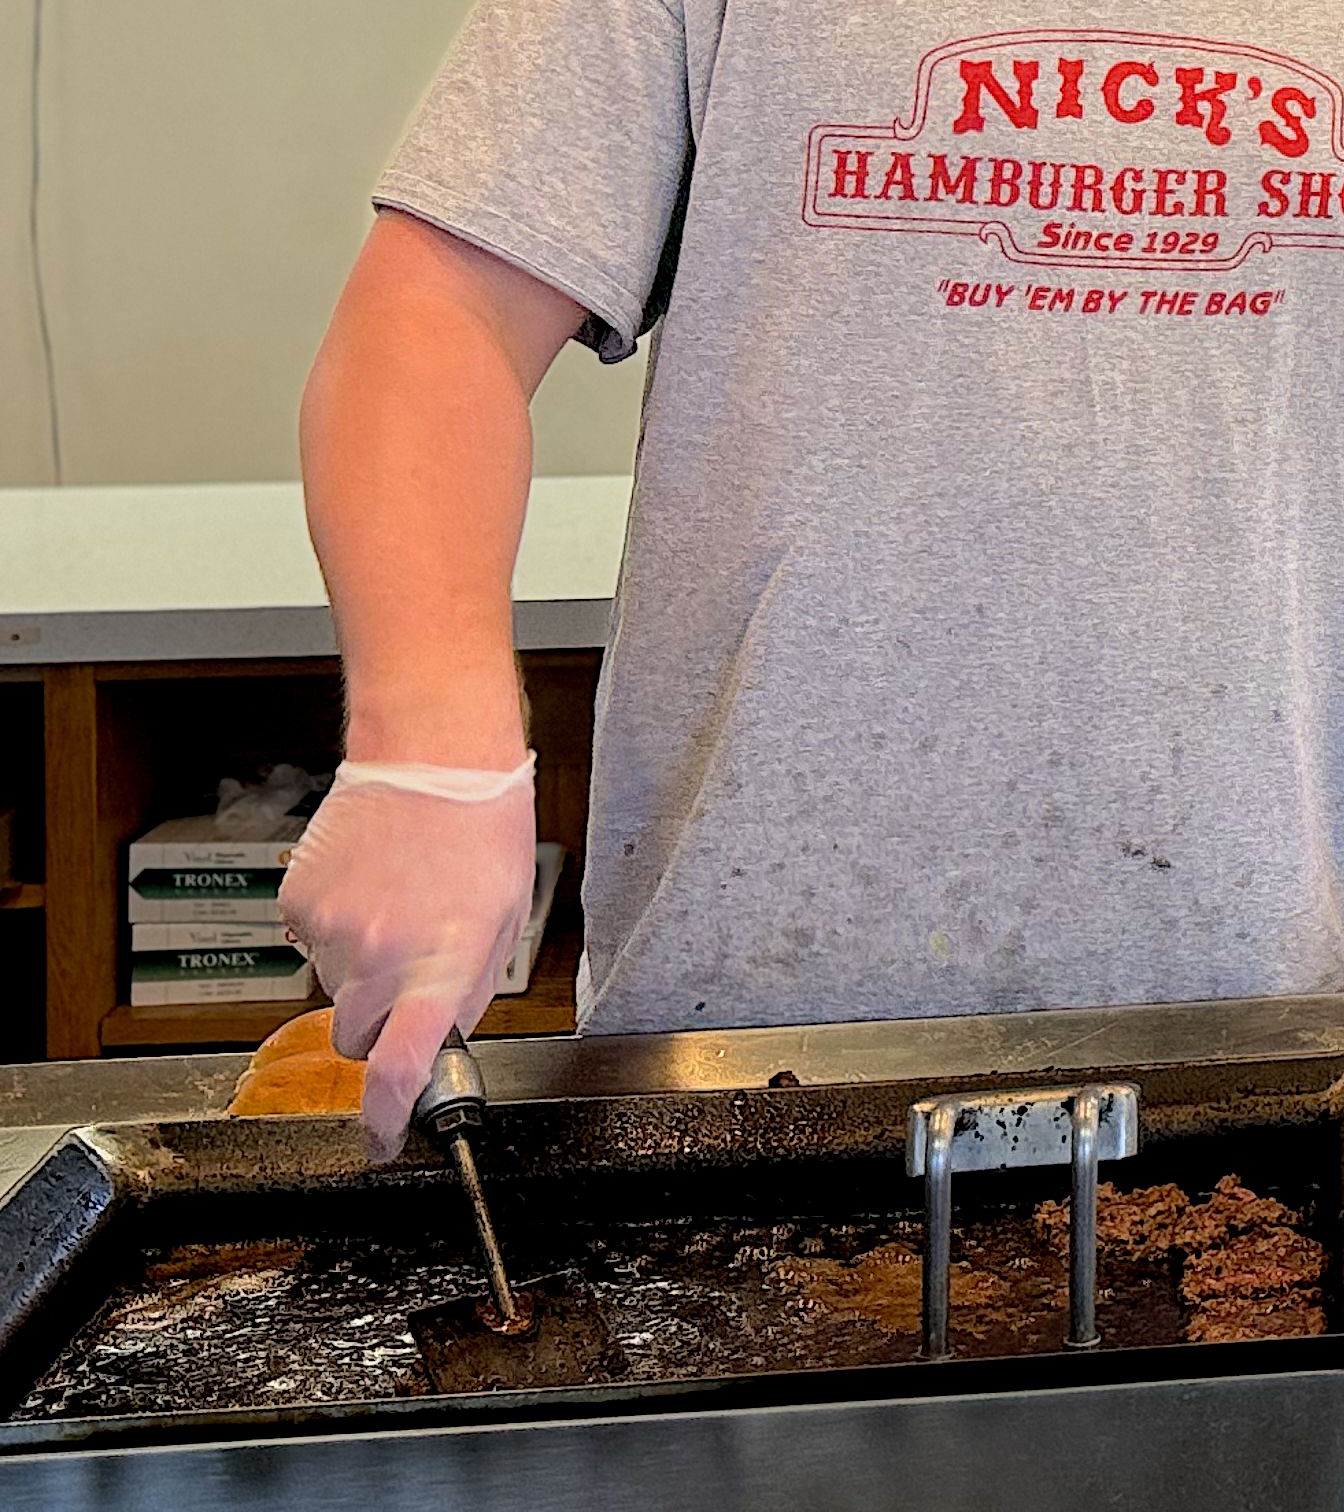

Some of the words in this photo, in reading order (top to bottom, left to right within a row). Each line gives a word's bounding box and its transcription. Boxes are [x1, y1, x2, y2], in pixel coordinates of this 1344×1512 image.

[952, 56, 1318, 159] NICK'S
[827, 149, 1228, 218] HAMBURGER
[1036, 221, 1134, 254] Since
[1141, 230, 1219, 255] 1929
[938, 279, 1013, 308] "BUY
[1024, 286, 1075, 313] 'EM
[1082, 289, 1125, 314] BY
[1139, 290, 1199, 316] THE
[1206, 290, 1286, 317] BAG"
[173, 873, 248, 888] TRONEX
[177, 953, 256, 969] TRONEX
